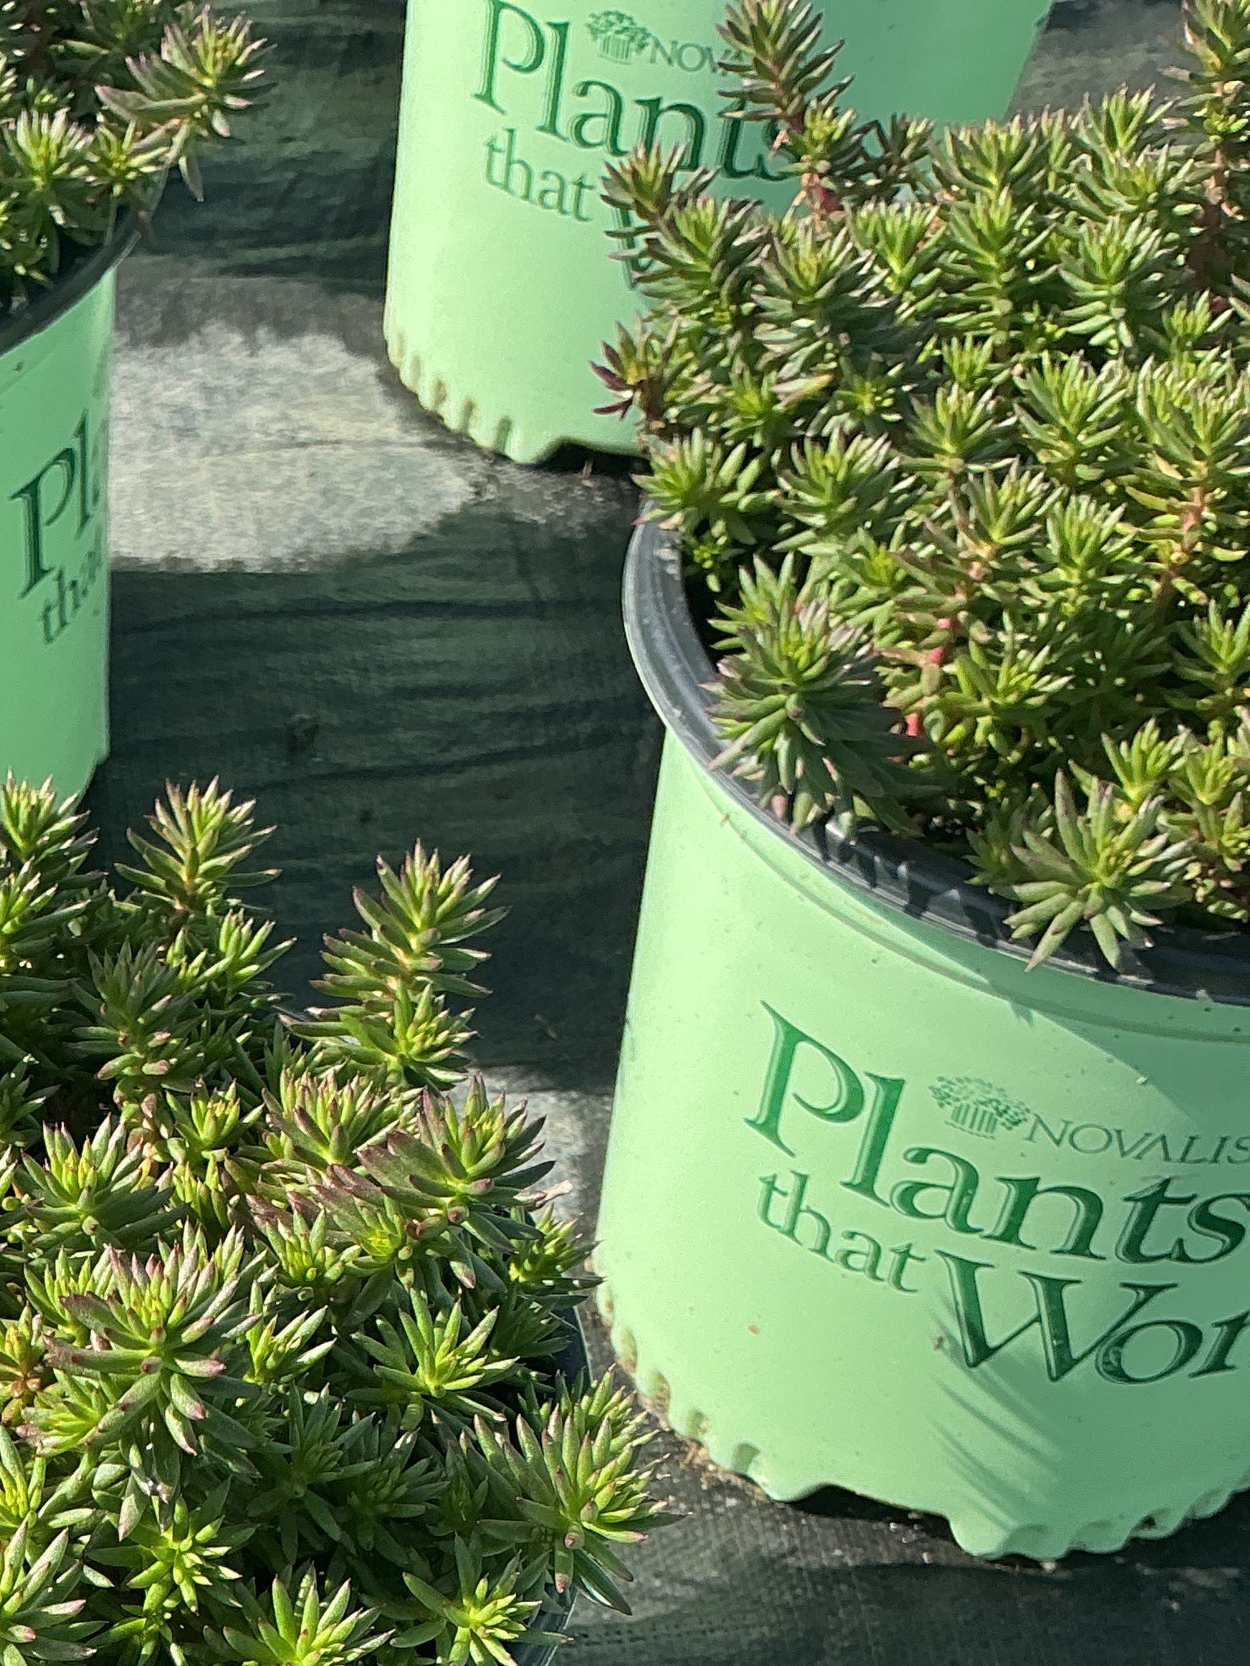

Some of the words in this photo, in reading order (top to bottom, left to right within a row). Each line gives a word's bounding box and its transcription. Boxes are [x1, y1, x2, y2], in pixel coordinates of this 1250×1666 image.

[483, 127, 598, 223] that
[744, 1000, 1250, 1265] Plants
[756, 1170, 927, 1293] that
[934, 1250, 1250, 1385] Wor
